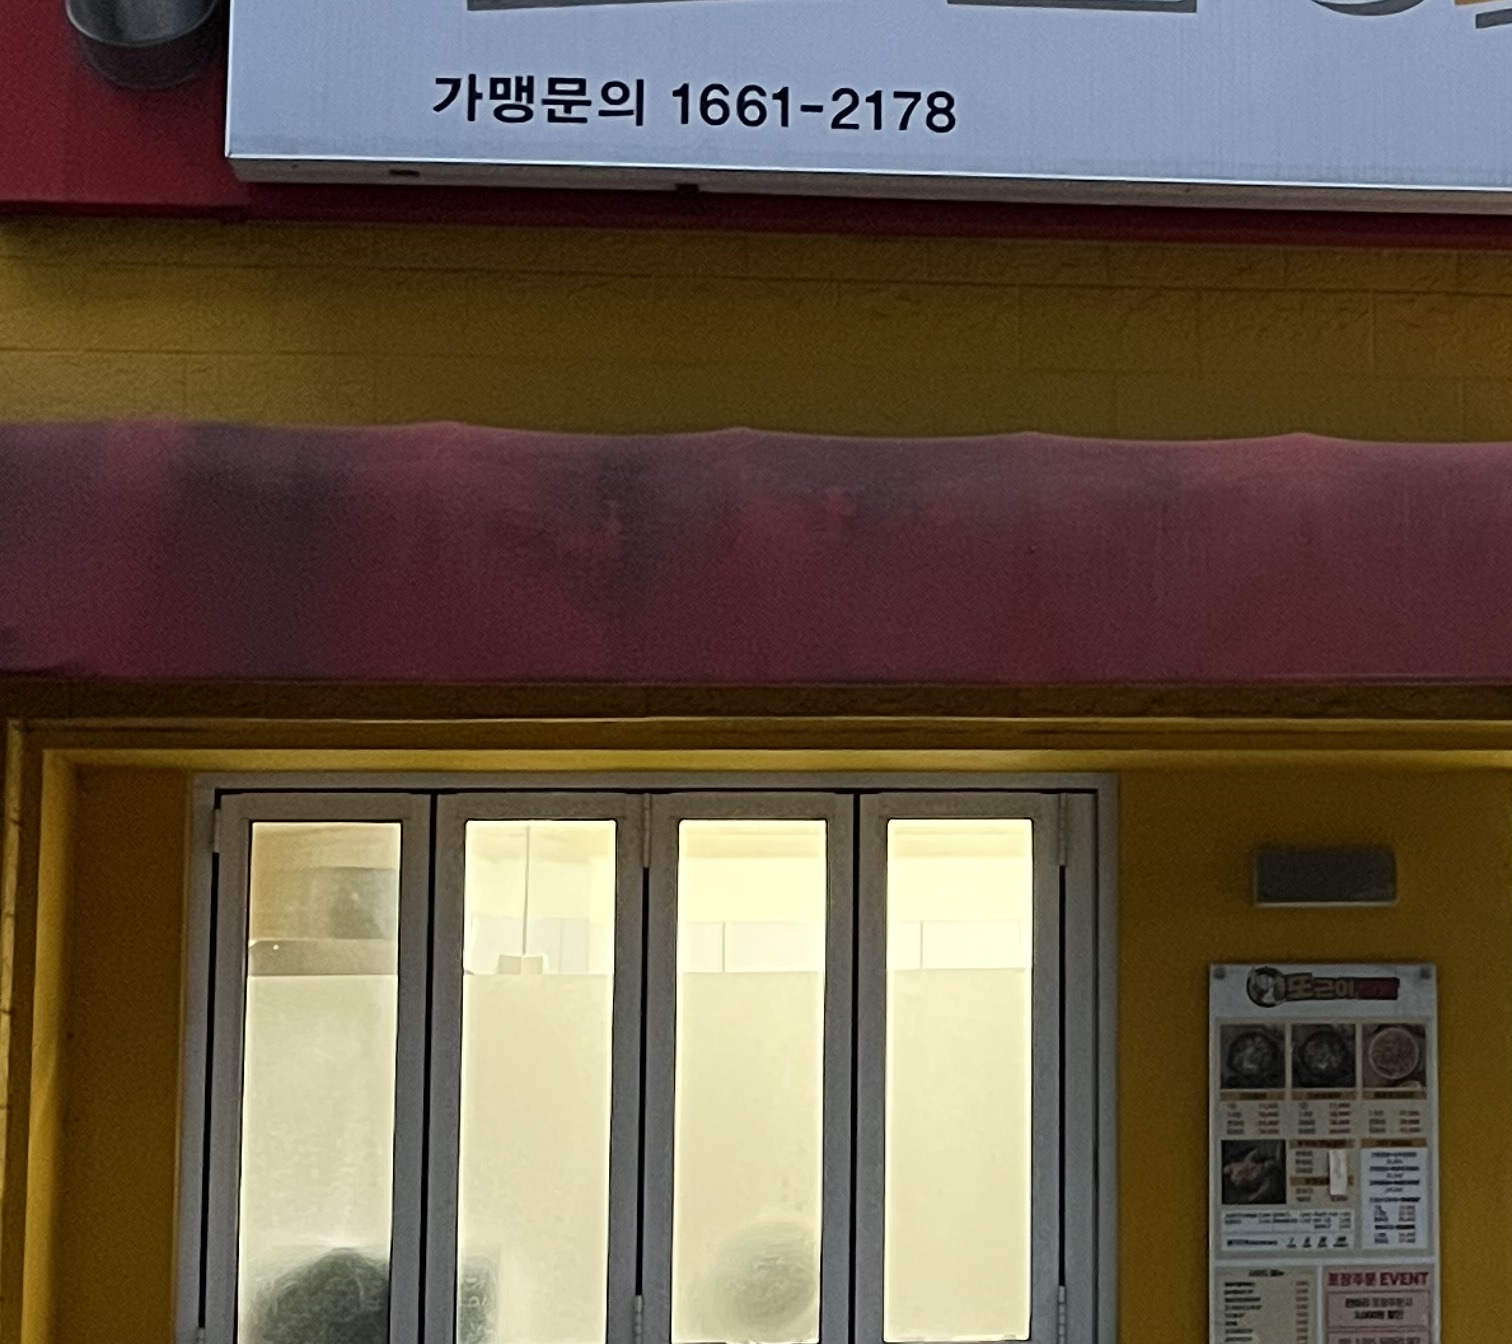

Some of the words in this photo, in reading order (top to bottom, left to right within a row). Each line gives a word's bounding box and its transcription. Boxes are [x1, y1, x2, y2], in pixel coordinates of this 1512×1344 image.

[432, 71, 648, 128] 가맹문의
[672, 79, 957, 135] 1661-2178
[1380, 1272, 1429, 1286] EVENT
